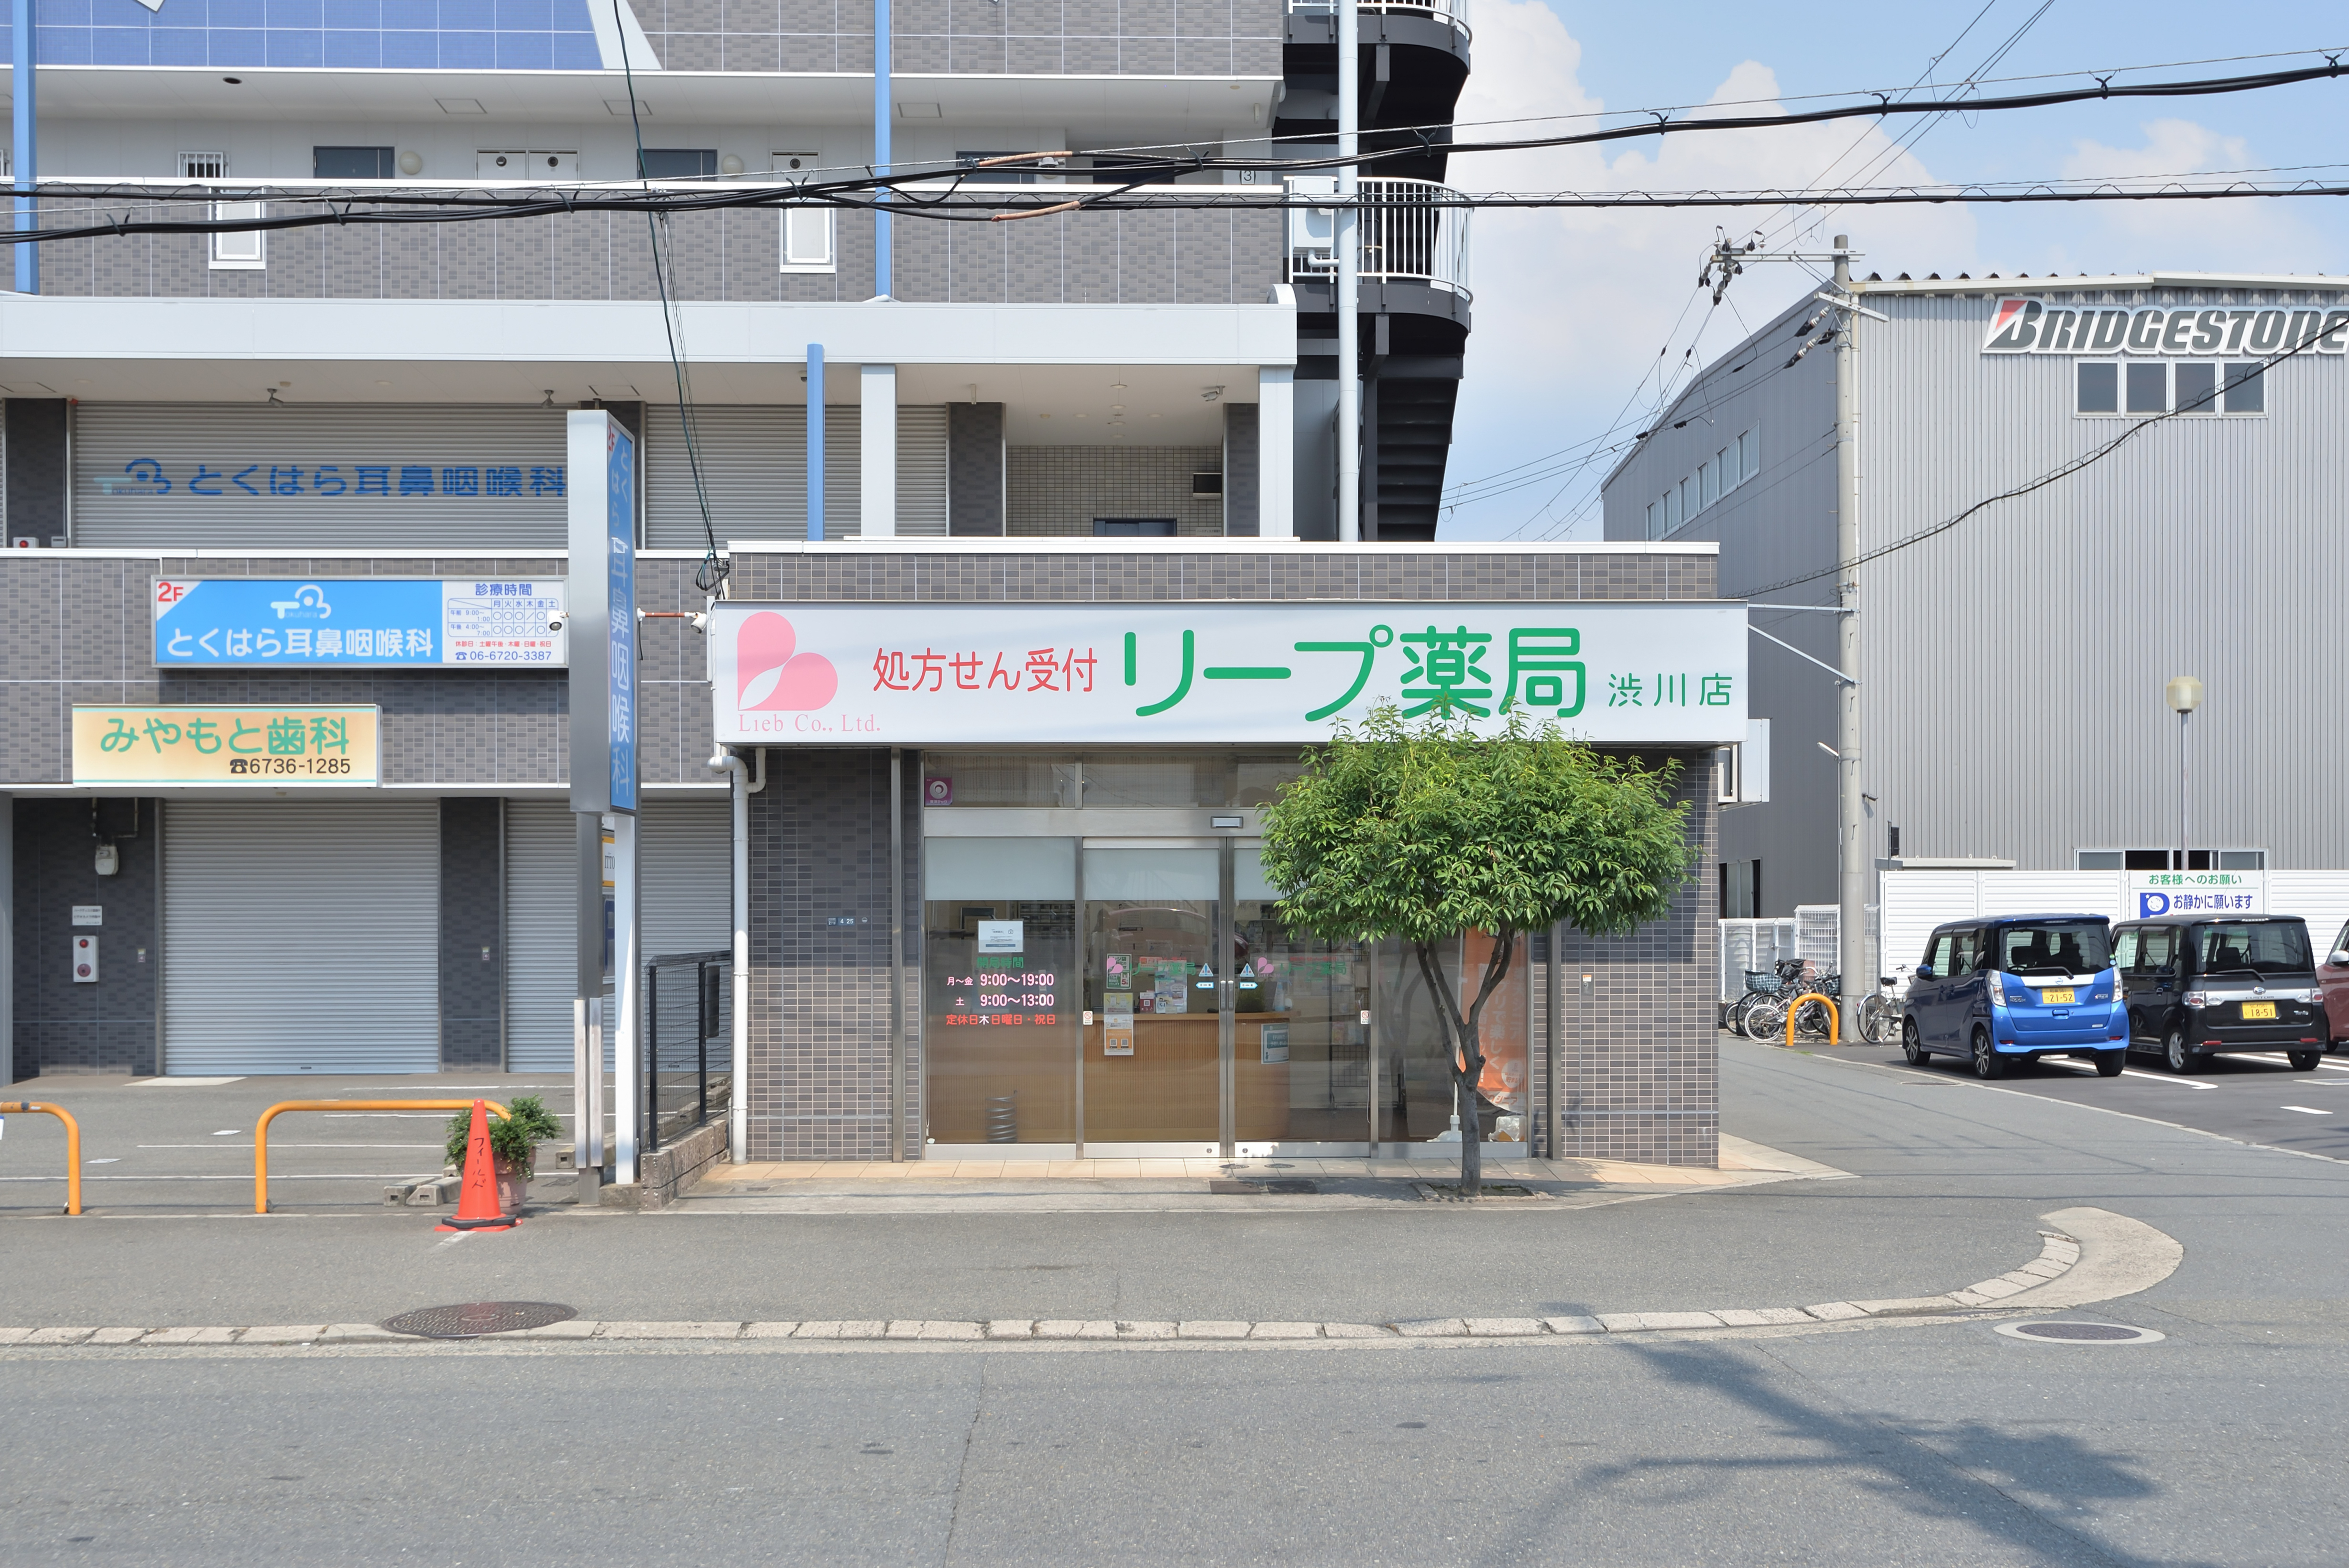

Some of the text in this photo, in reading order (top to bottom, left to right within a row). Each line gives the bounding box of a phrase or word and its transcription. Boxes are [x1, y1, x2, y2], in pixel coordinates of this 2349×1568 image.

[1984, 300, 2349, 349] BRIDGESTONE
[189, 464, 567, 497] とくはら耳鼻咽喉科
[158, 582, 184, 602] 2F
[475, 583, 532, 596] 診療時間
[167, 628, 433, 657] とくはら耳鼻咽喉科
[470, 651, 551, 660] 06-6720-3387
[873, 624, 1732, 722] 処方せん受付 リープ薬局 渋川店
[795, 713, 832, 733] Co.,
[841, 713, 880, 732] Ltd.
[100, 716, 349, 755] みやもと歯科
[250, 758, 350, 774] 6736-1285
[2149, 874, 2242, 885] お客様へのお願い
[2174, 894, 2253, 910] お静かに願います
[977, 957, 1024, 969] 開局時間
[956, 997, 964, 1006] 土
[2050, 993, 2073, 1002] 21-52
[2251, 1008, 2273, 1017] 18-51
[471, 1137, 487, 1189] フィールド
